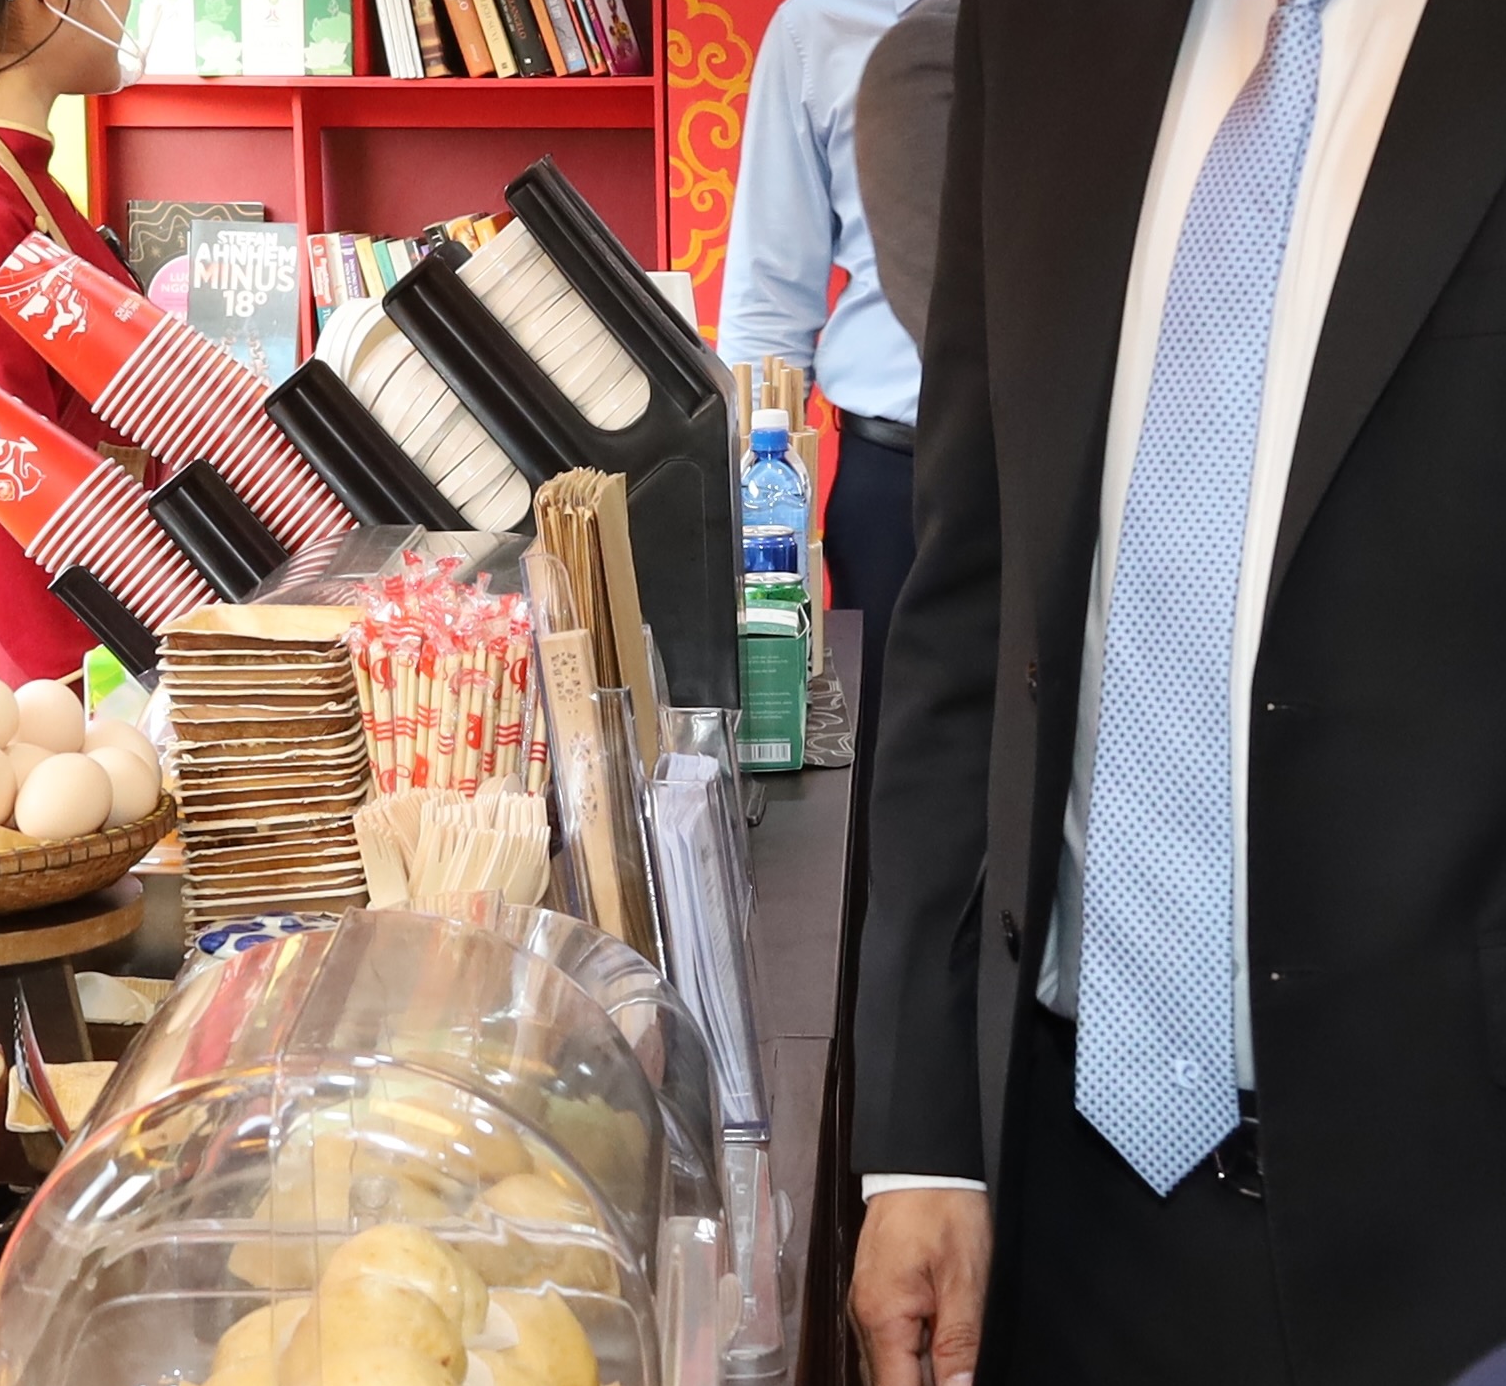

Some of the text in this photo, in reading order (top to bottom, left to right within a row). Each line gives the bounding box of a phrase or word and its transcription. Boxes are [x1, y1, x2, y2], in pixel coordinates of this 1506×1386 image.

[217, 230, 278, 246] STEFAN
[195, 242, 298, 267] AHNHEM
[193, 262, 295, 293] MINUS
